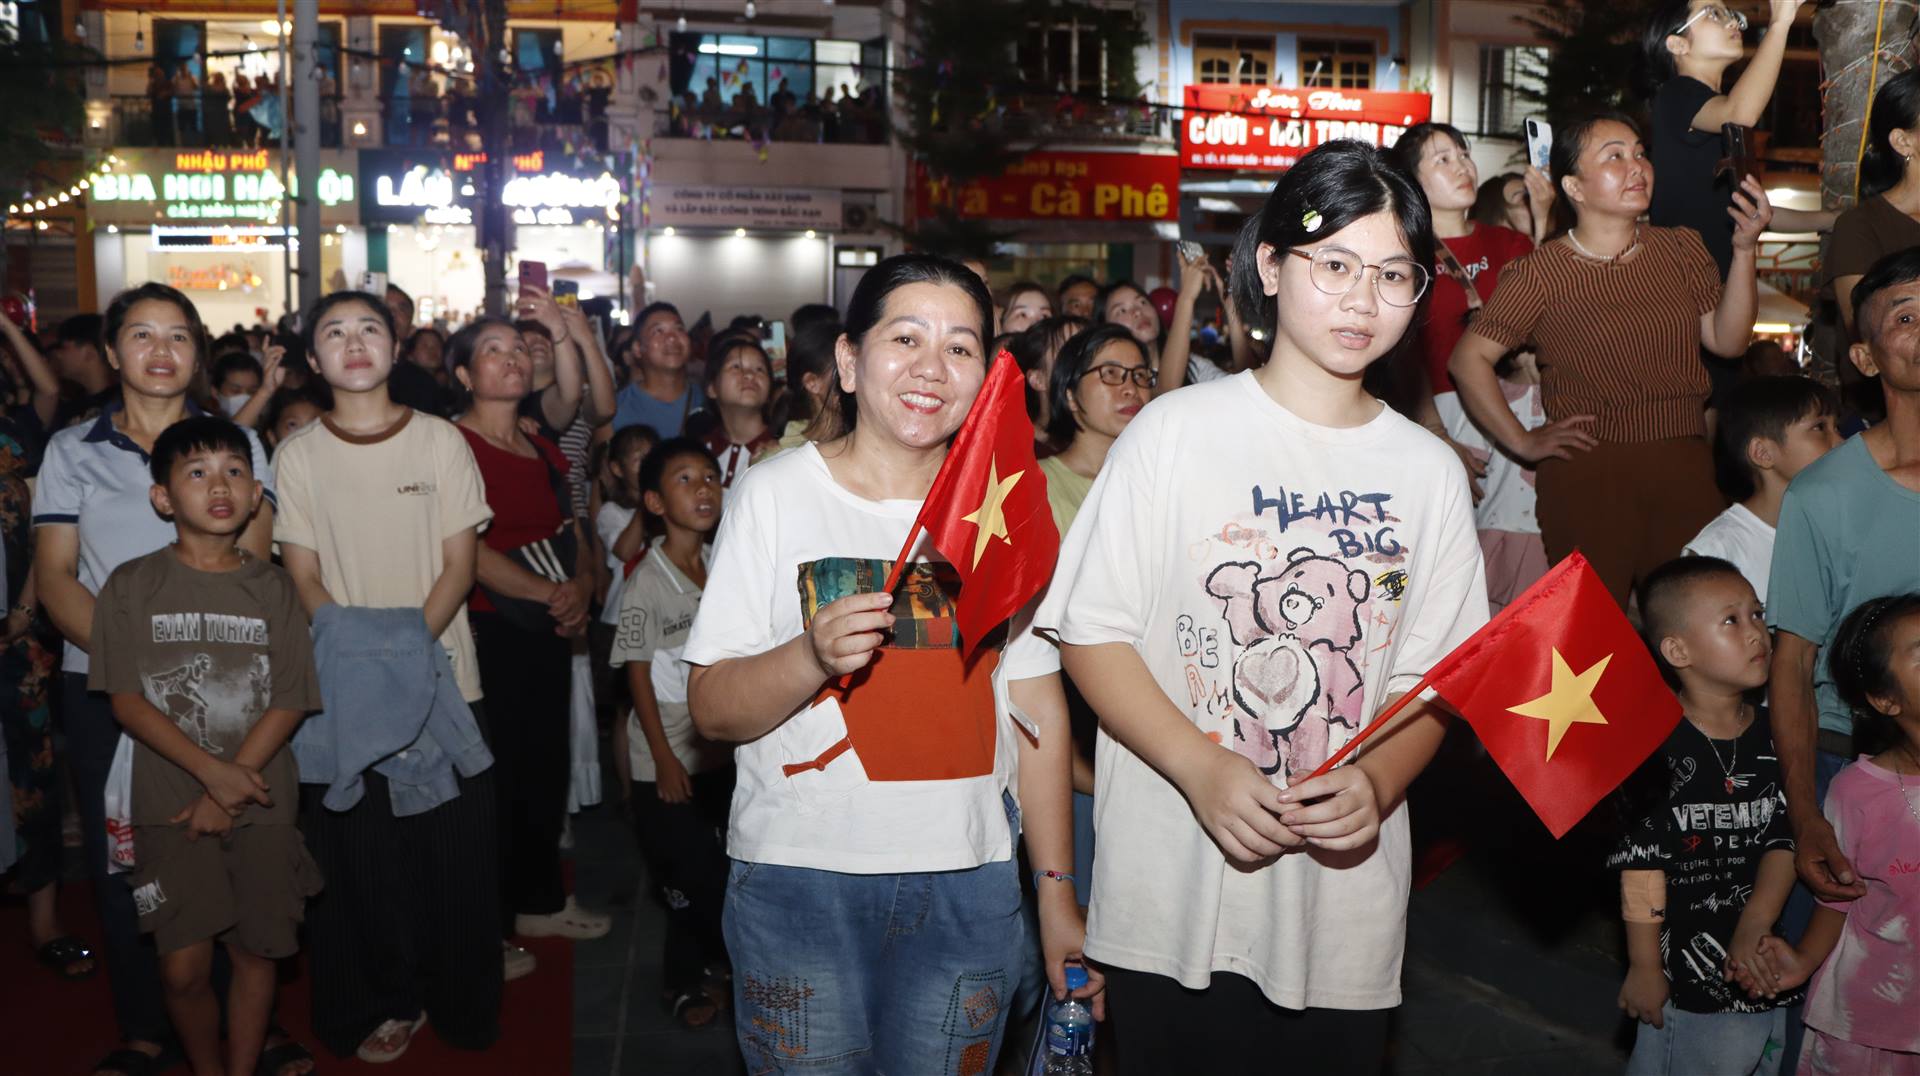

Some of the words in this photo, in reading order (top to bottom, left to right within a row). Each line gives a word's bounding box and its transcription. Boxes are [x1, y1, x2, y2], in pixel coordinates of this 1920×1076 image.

[93, 173, 157, 200] BIA
[1095, 183, 1168, 217] Phê
[1252, 485, 1393, 533] HEART
[1328, 526, 1400, 558] BIG
[152, 613, 201, 643] EVAN
